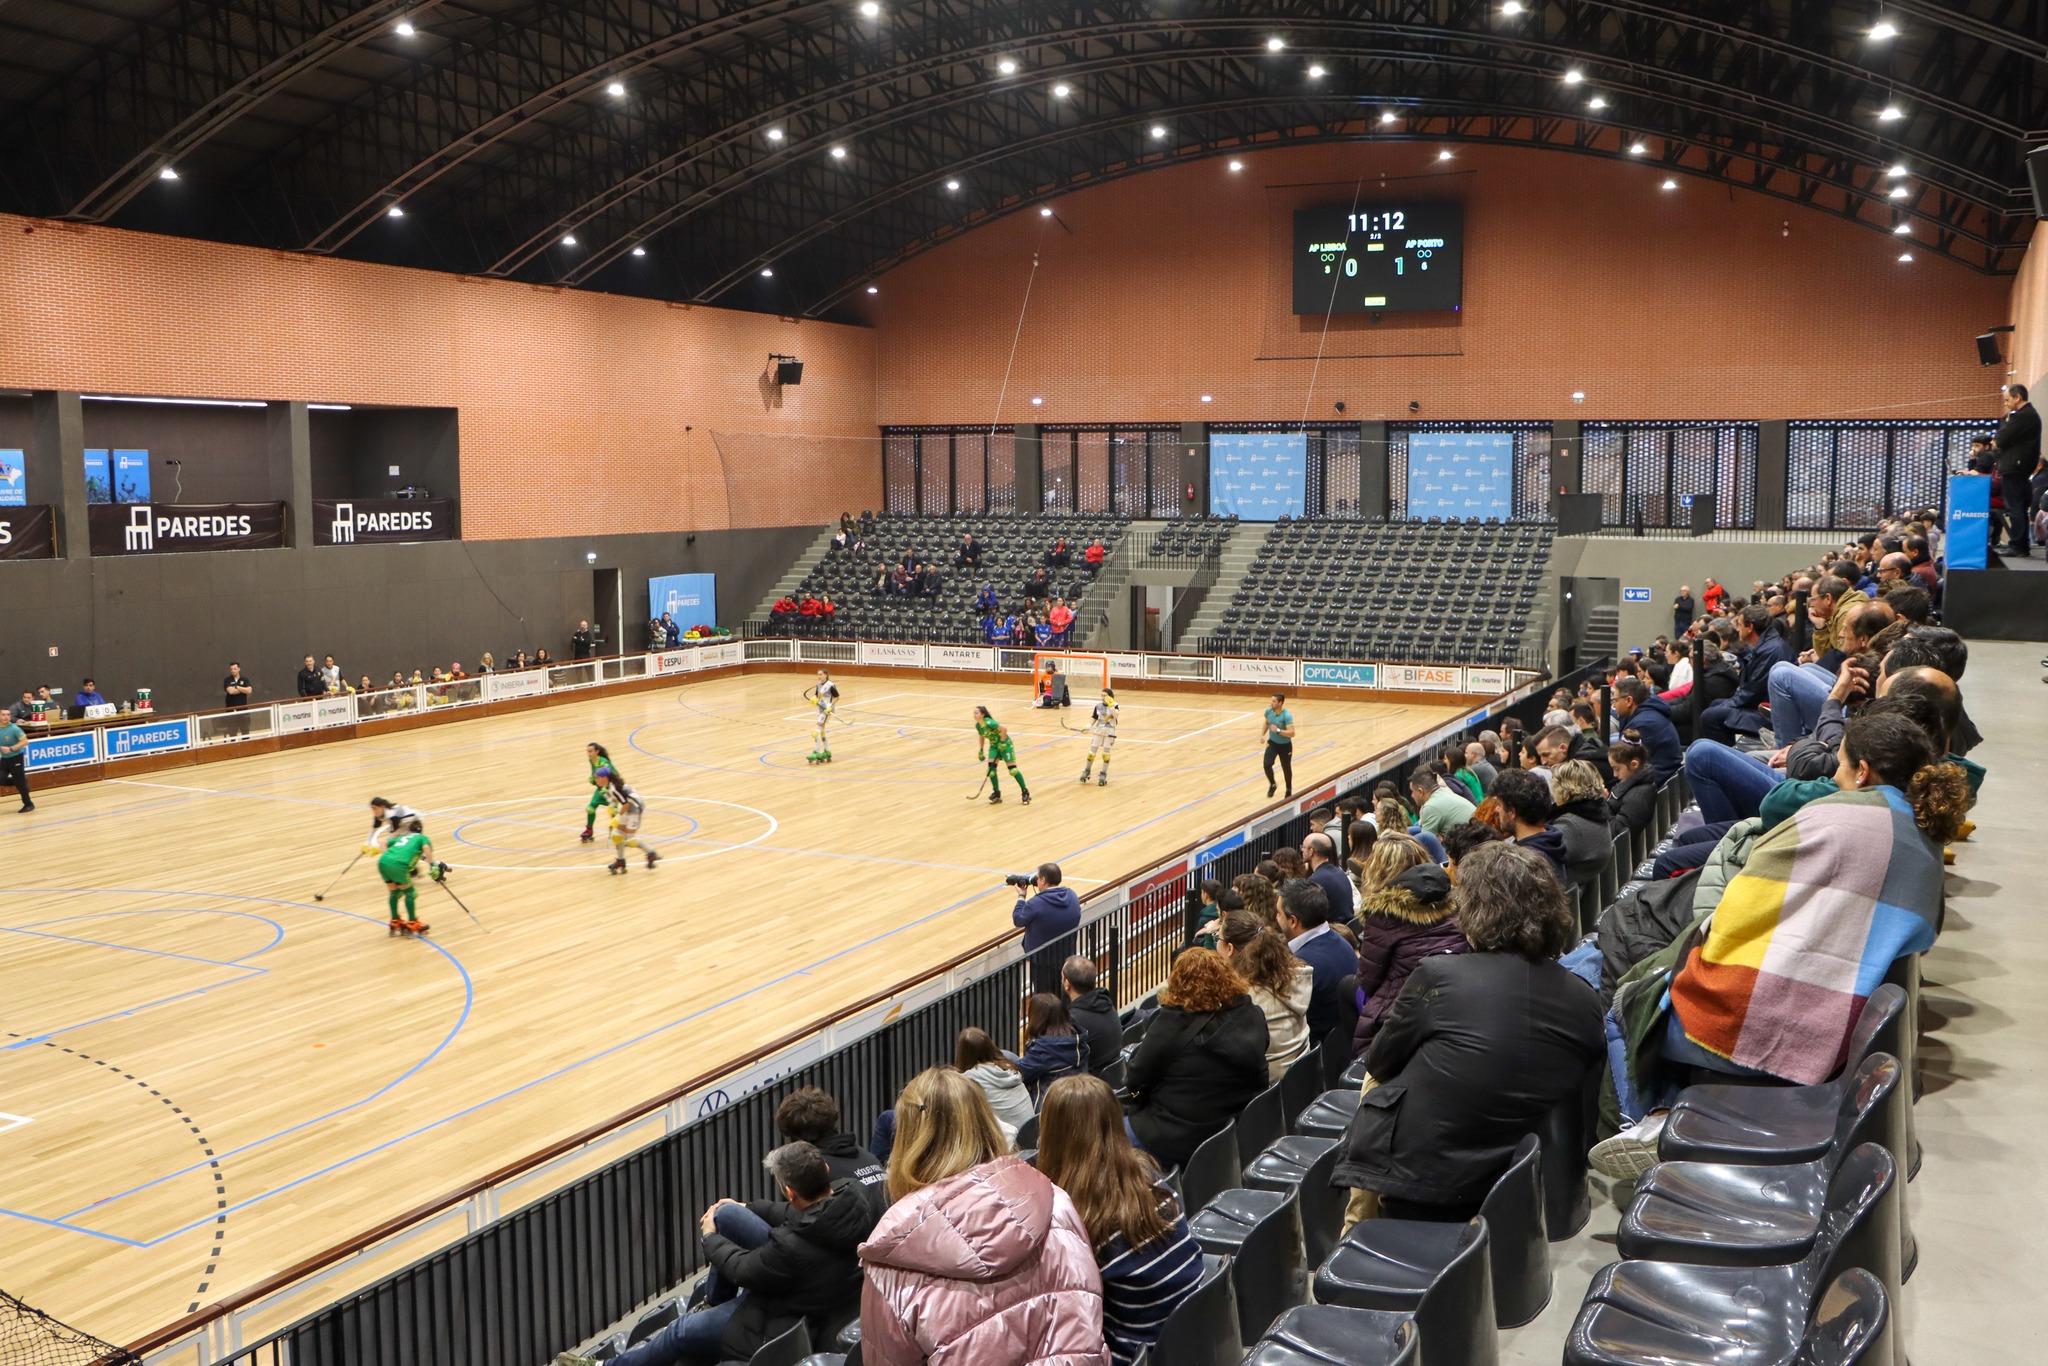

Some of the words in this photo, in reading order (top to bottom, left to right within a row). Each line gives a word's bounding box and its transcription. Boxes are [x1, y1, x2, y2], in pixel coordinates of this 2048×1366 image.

[1348, 212, 1405, 232] 11:12
[1345, 258, 1358, 277] 0
[1395, 256, 1404, 275] 1
[157, 514, 252, 538] PAREDES
[357, 510, 433, 532] PAREDES
[1636, 591, 1648, 599] WC
[678, 598, 700, 607] PAREDES
[877, 648, 917, 658] LASKASAS
[943, 650, 981, 659] ANTARTE
[664, 656, 681, 667] CESPU
[1239, 662, 1285, 673] LASKASAS
[1404, 669, 1454, 683] BIFASE
[292, 711, 312, 721] martins
[327, 707, 347, 716] martins
[131, 729, 180, 746] PAREDES
[32, 742, 86, 760] PAREDES
